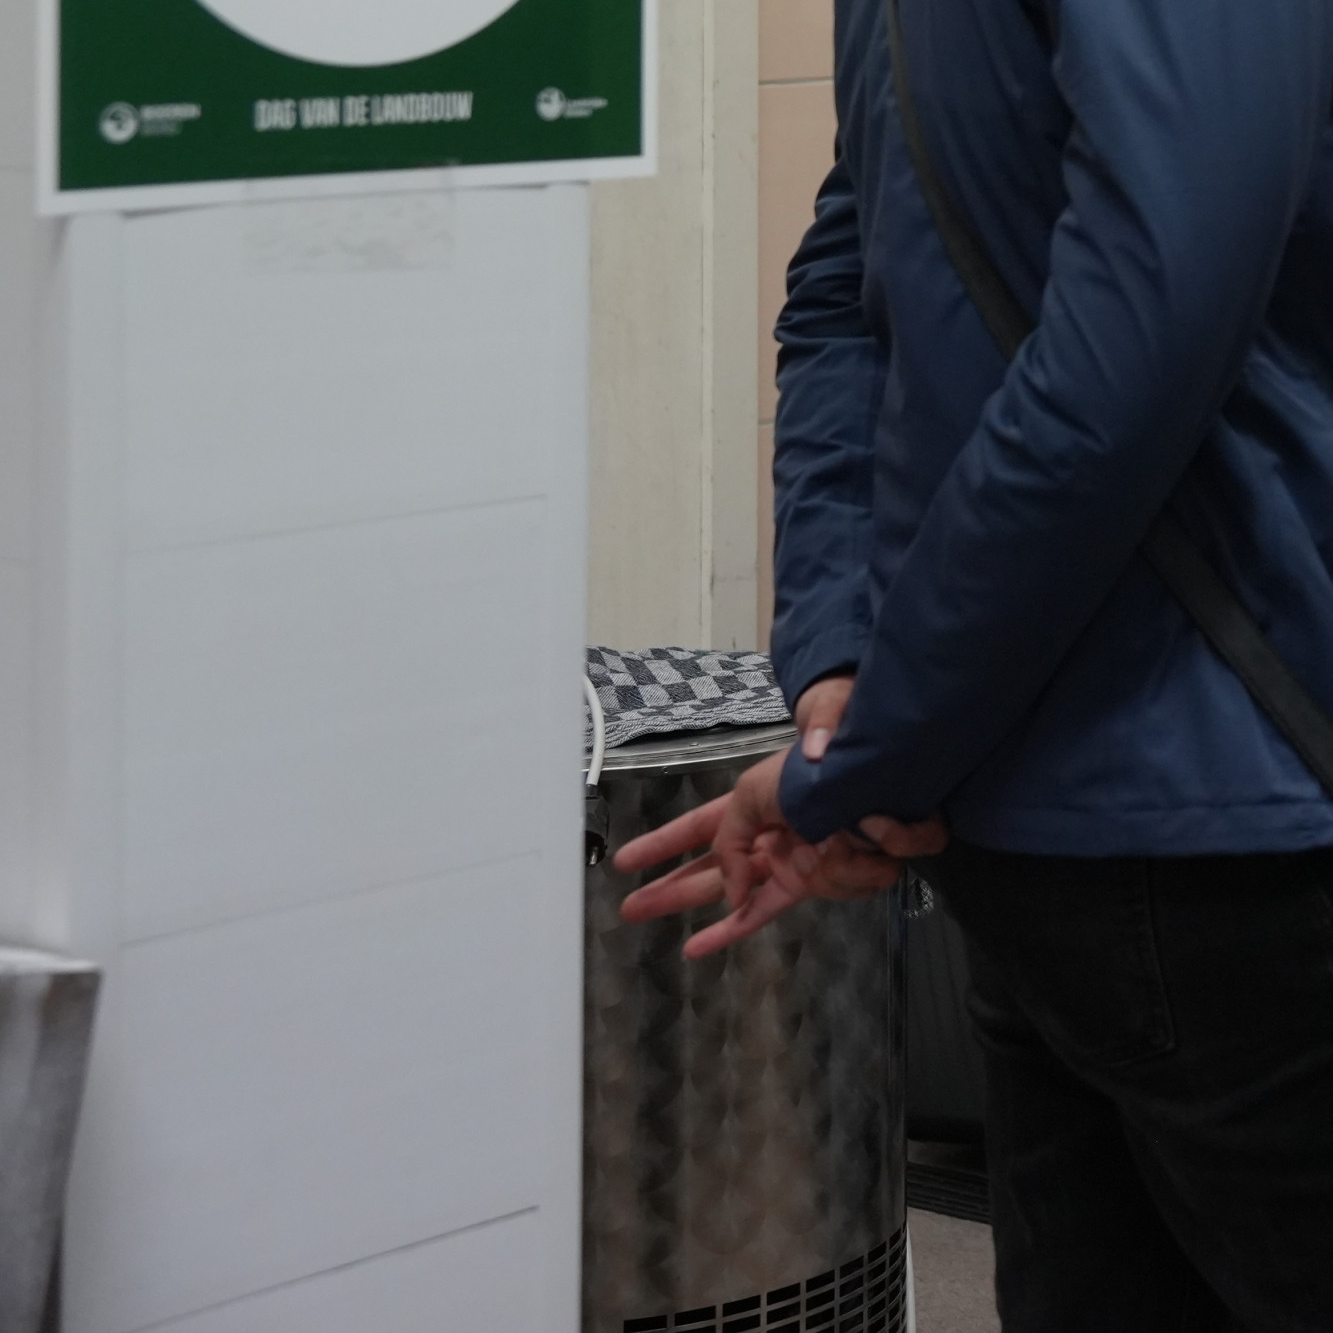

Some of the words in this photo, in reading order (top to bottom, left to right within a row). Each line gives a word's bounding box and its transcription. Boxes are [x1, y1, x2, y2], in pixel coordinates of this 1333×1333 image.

[254, 99, 296, 131] DAG
[301, 97, 340, 129] VAN
[343, 95, 370, 126] DE
[372, 91, 473, 125] LANDBOUW
